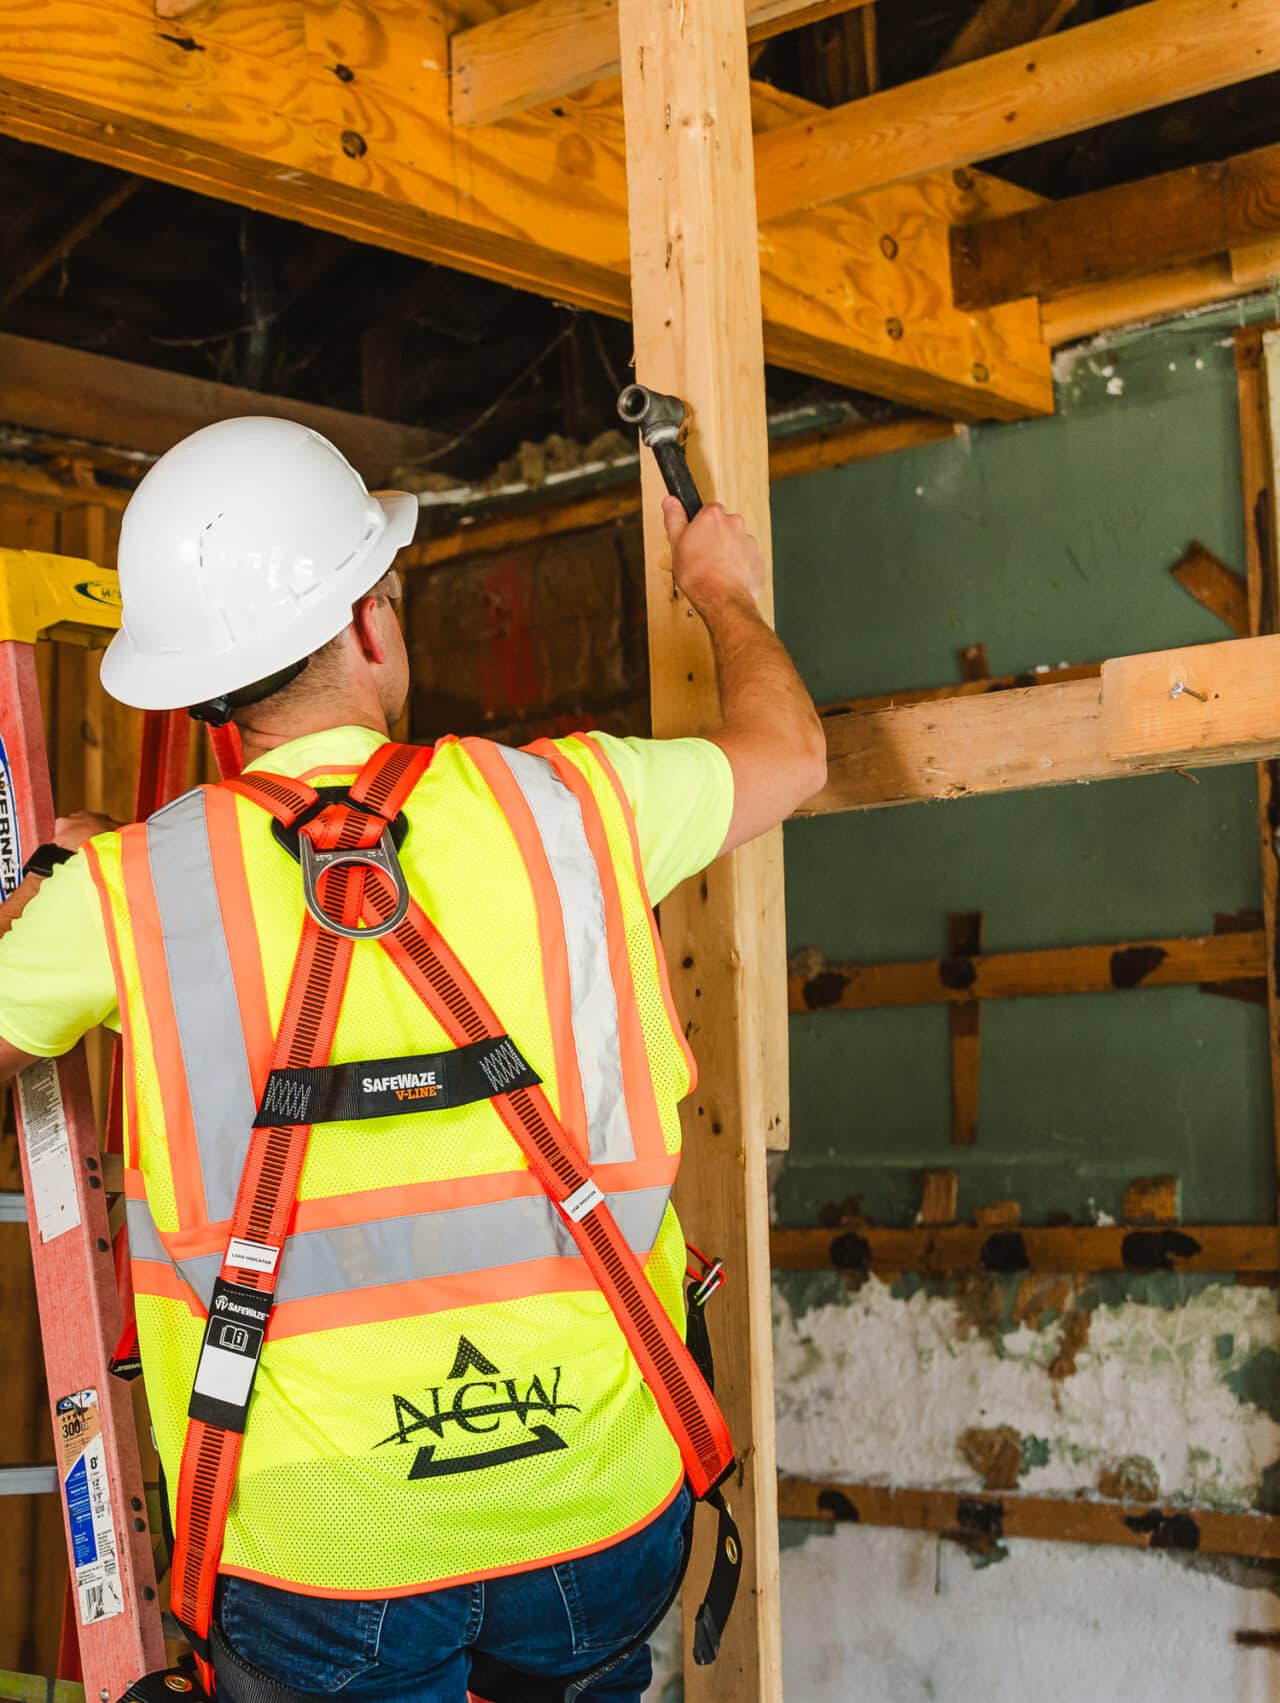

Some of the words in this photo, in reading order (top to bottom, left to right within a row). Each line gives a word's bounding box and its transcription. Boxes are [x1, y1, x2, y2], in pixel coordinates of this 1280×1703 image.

[362, 1071, 436, 1093] SAFEWAZE
[395, 1087, 437, 1101] V-LINE
[228, 1302, 266, 1321] SAFEWAZE
[63, 1419, 81, 1439] 300
